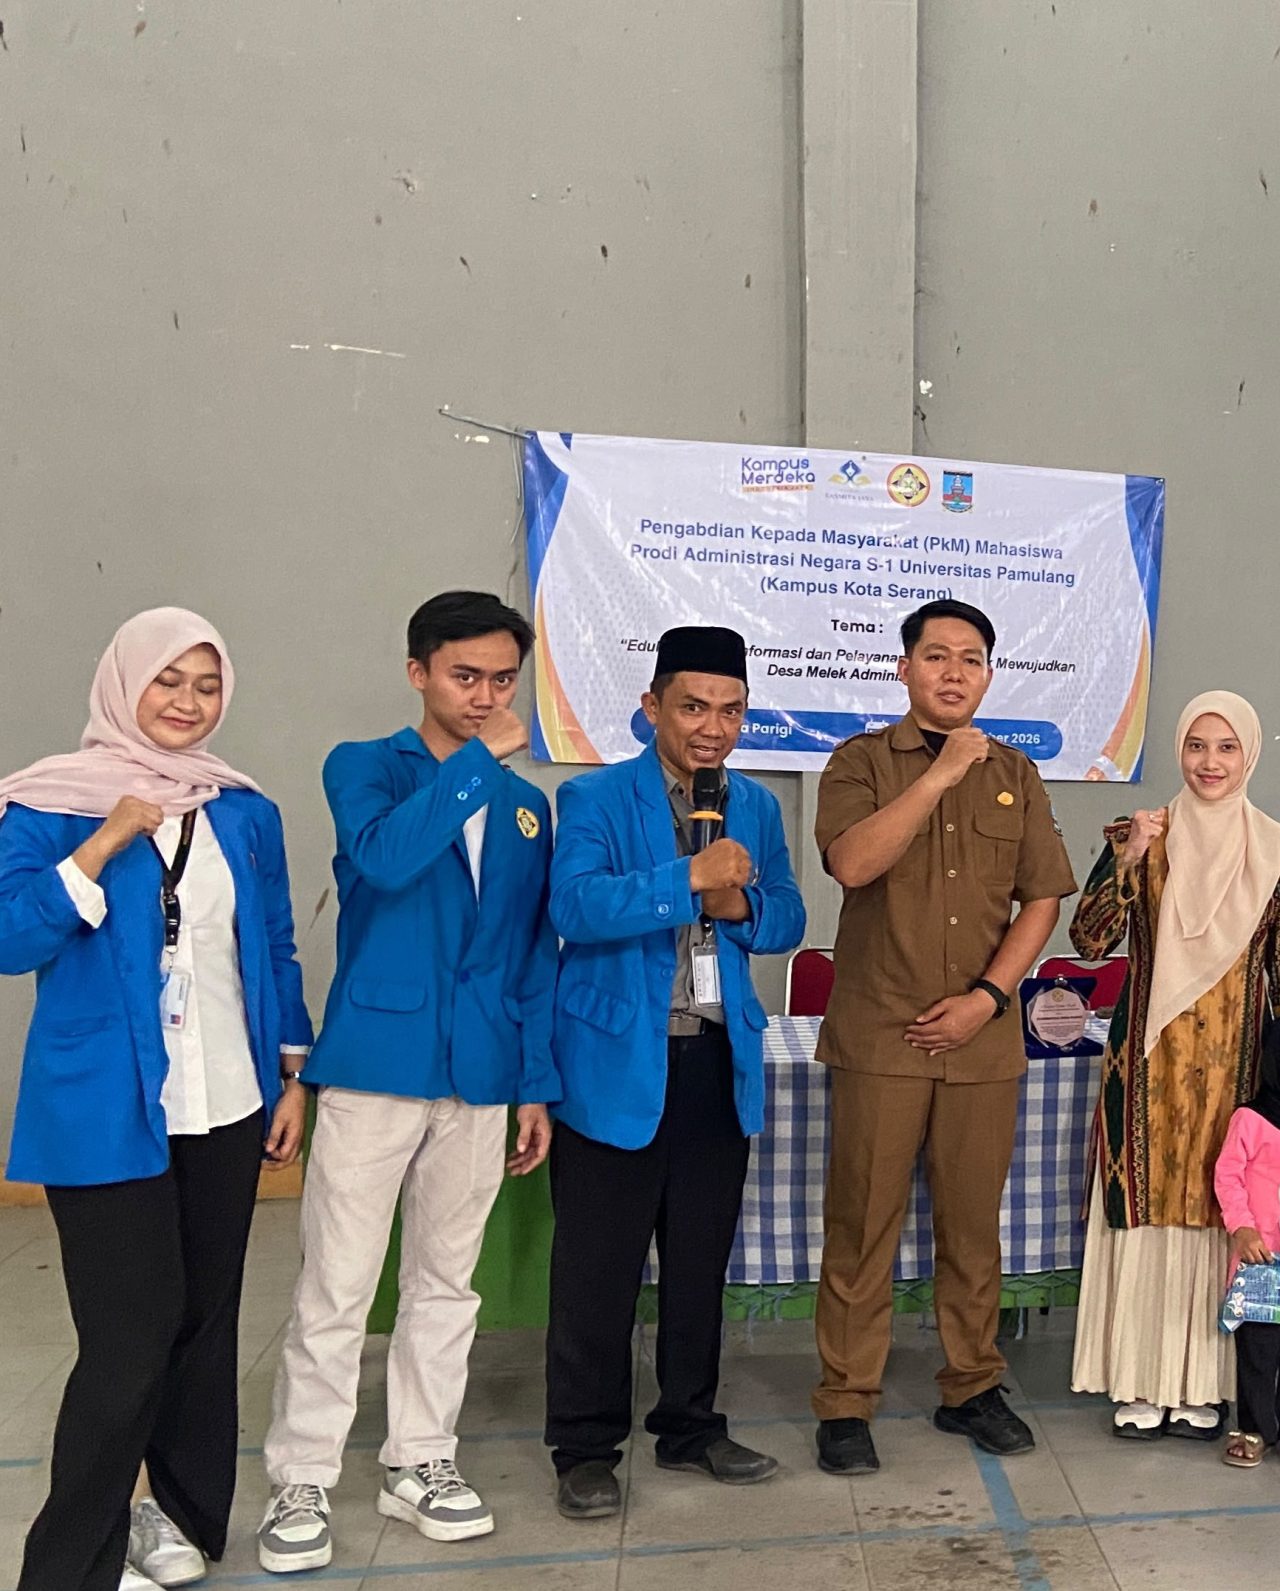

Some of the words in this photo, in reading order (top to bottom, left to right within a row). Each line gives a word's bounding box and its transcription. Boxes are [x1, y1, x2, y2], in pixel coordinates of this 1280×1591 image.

[741, 457, 810, 474] Kampus
[741, 471, 816, 485] Merdeka
[640, 519, 744, 539] Pengabdian
[751, 525, 816, 544] Kepada
[924, 536, 970, 556] (PkM)
[976, 540, 1063, 559] Mahasiswa
[631, 544, 677, 560] Prodi
[684, 546, 795, 567] Administrasi
[801, 553, 861, 572] Negara
[867, 557, 893, 572] S-1
[900, 559, 992, 579] Universitas
[997, 566, 1075, 587] Pamulang
[760, 576, 838, 596] (Kampus
[844, 581, 882, 597] Kota
[830, 619, 876, 633] Tema
[805, 648, 832, 661] dan
[836, 648, 899, 665] Pelayana
[995, 657, 1076, 674] Mewujudkan
[767, 664, 803, 677] Desa
[806, 665, 847, 680] Melek
[849, 668, 902, 682] Admini
[752, 722, 793, 738] Parigi
[1011, 733, 1041, 745] 2026
